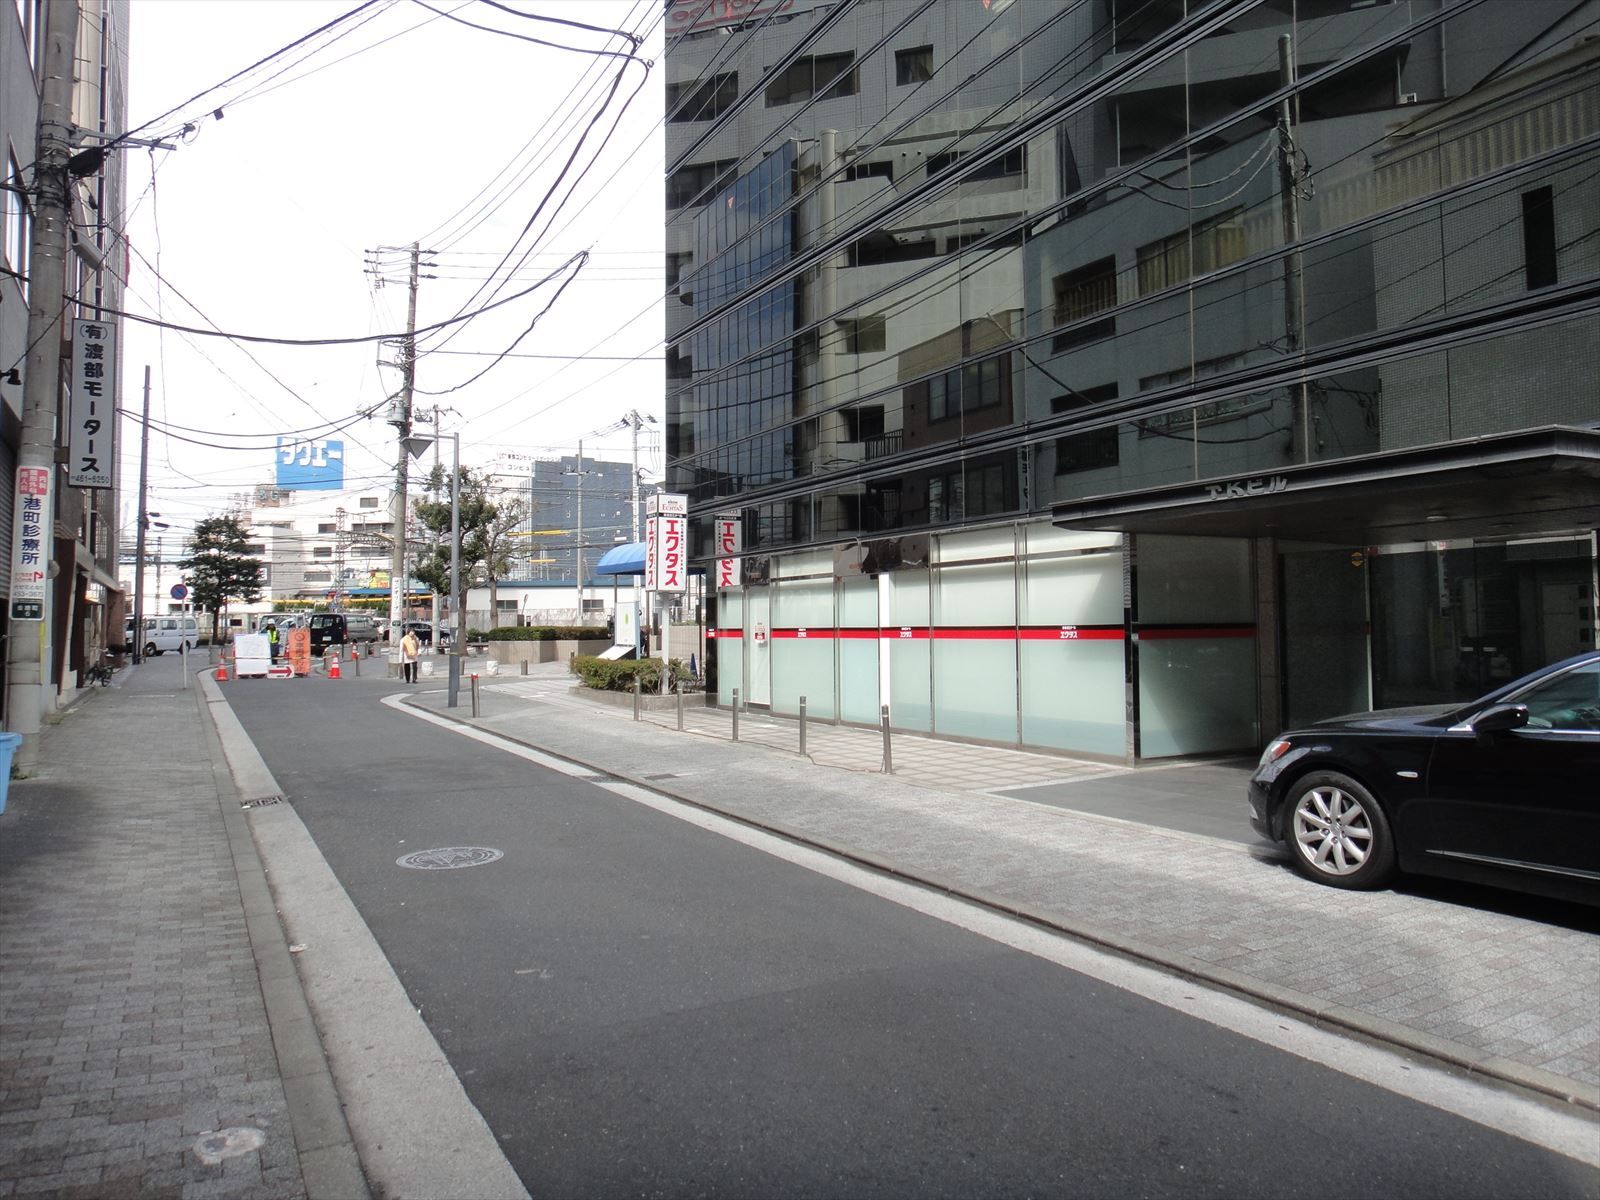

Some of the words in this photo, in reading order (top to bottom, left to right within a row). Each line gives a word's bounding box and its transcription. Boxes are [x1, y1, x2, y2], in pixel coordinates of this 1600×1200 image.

[22, 494, 41, 565] 港町診療所
[665, 519, 679, 586] エクタス
